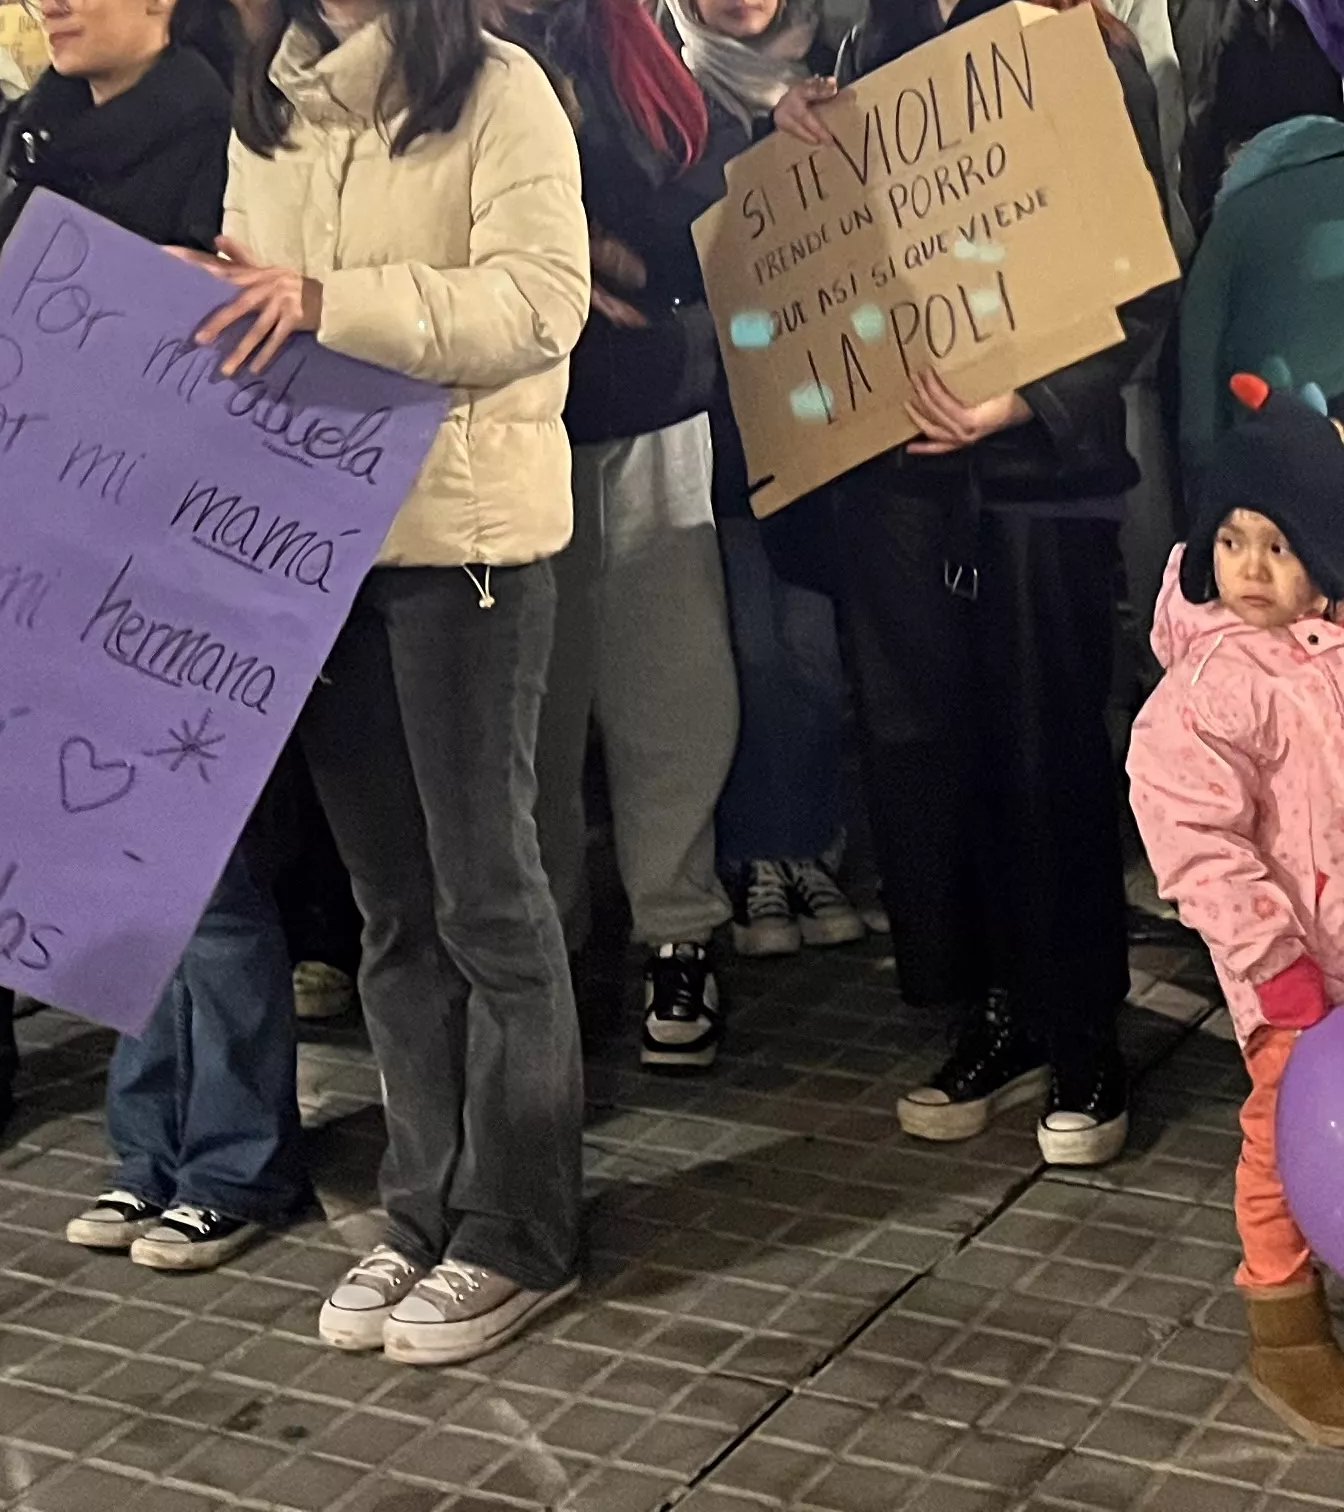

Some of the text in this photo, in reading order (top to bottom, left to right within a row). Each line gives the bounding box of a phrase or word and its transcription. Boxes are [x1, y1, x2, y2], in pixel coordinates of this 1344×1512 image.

[742, 31, 1034, 241] SI TE VIOLAN
[840, 204, 874, 238] UN
[888, 141, 1007, 229] PORRO
[904, 230, 950, 269] QUE
[959, 187, 1050, 245] VIENE
[12, 217, 126, 351] Por
[224, 353, 393, 485] abuela
[890, 270, 1016, 381] POLI
[58, 443, 148, 500] mi
[169, 478, 362, 594] mamá
[80, 554, 278, 716] hermana
